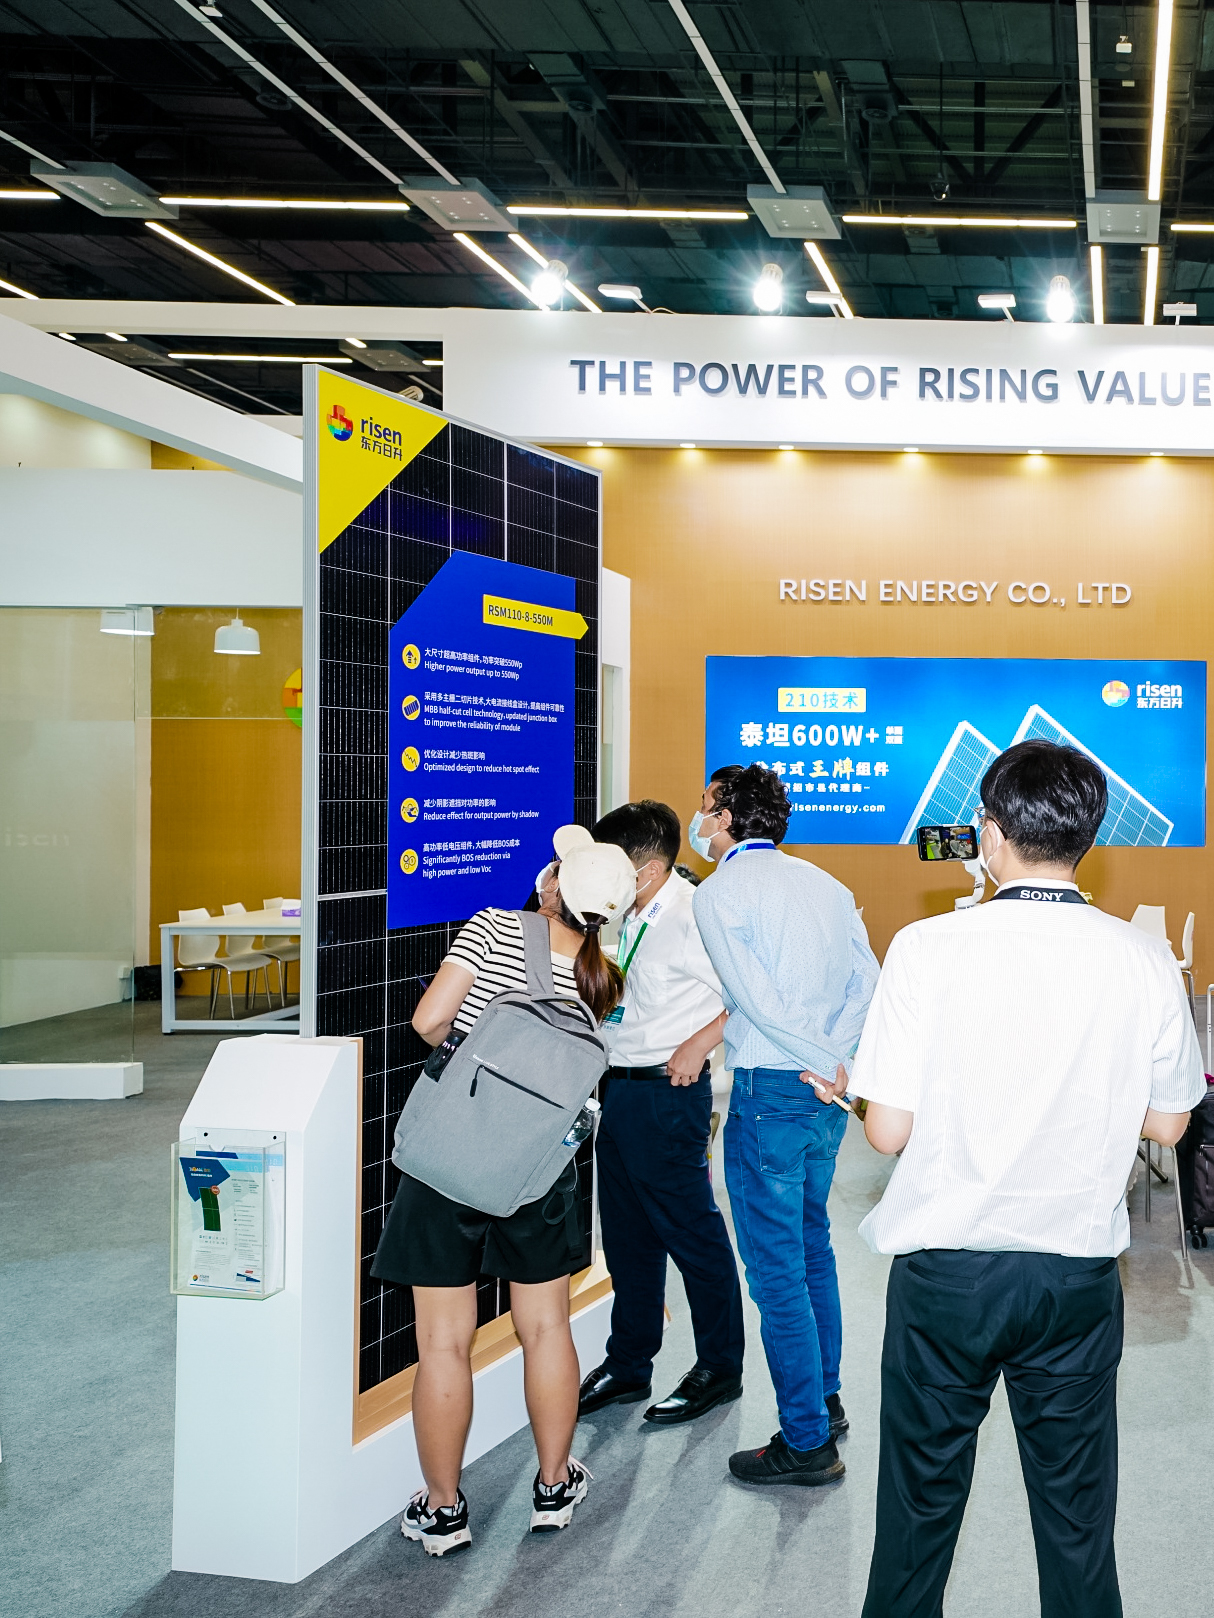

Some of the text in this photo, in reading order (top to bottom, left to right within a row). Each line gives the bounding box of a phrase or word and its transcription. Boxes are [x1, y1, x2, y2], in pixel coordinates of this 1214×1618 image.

[570, 359, 1212, 407] THE POWER OF RISING VALUE
[360, 417, 403, 447] risen
[360, 436, 403, 461] 东方日升
[778, 579, 1133, 607] RISEN ENERGY CO., LTD
[488, 604, 553, 627] RSM110-8-550M
[424, 660, 520, 681] Higher power output up to 550Wp
[1136, 681, 1183, 697] risen
[784, 691, 859, 709] 210技术
[1136, 697, 1183, 709] 东方日升
[424, 704, 439, 714] MBB
[439, 705, 462, 716] half-cut
[462, 707, 473, 717] cell
[506, 711, 527, 721] updated
[527, 712, 548, 722] junction
[548, 714, 558, 723] box
[424, 717, 521, 732] to improve the reliability of module
[739, 722, 880, 748] 泰坦600W+
[424, 762, 540, 775] Optimized design to reduce hot spot effect
[423, 809, 540, 821] Reduce effect for output power by shadow
[422, 850, 511, 867] Significantly BOS reduction via
[422, 864, 492, 880] high power and low Voc
[1020, 889, 1063, 901] SONY
